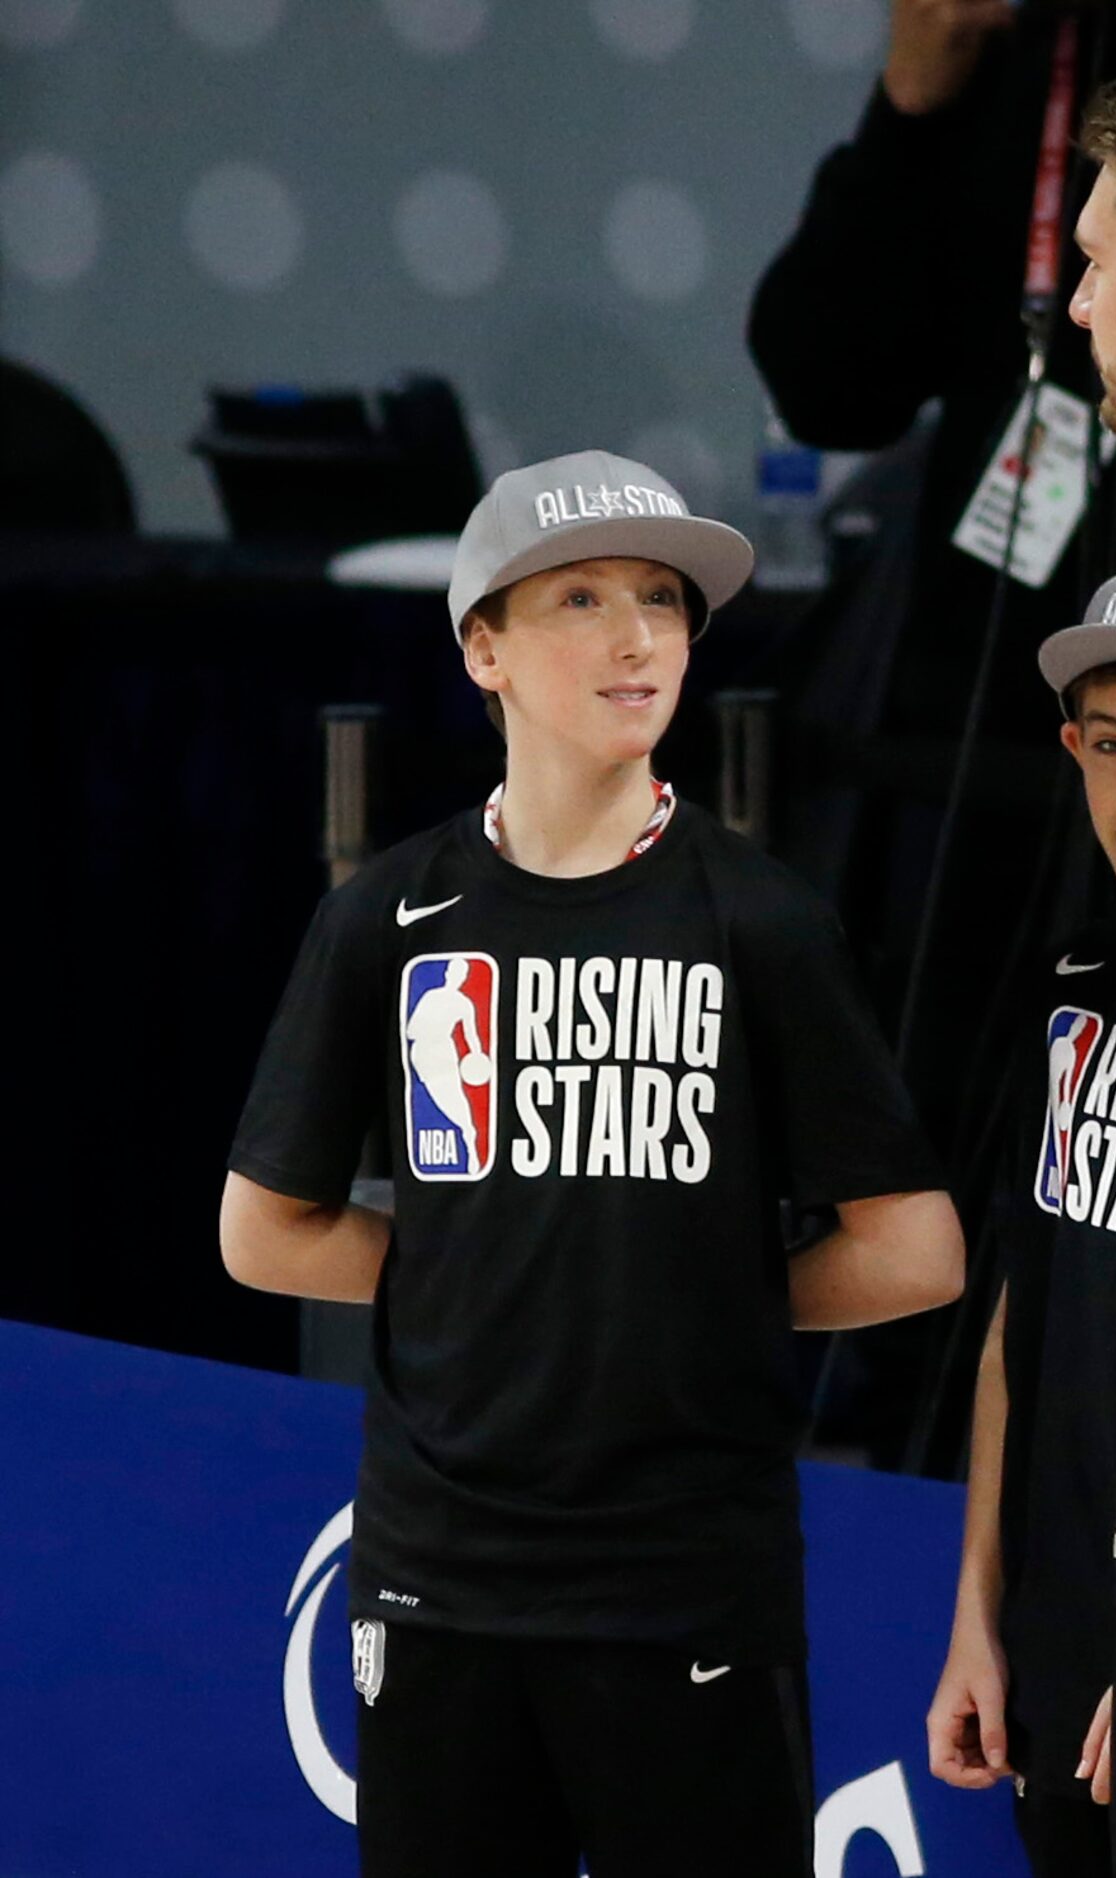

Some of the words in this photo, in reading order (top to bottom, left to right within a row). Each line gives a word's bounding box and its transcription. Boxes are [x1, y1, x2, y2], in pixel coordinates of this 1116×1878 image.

[535, 485, 600, 529] ALL
[515, 956, 724, 1069] RISING
[418, 1129, 459, 1166] NBA
[511, 1065, 716, 1184] STARS
